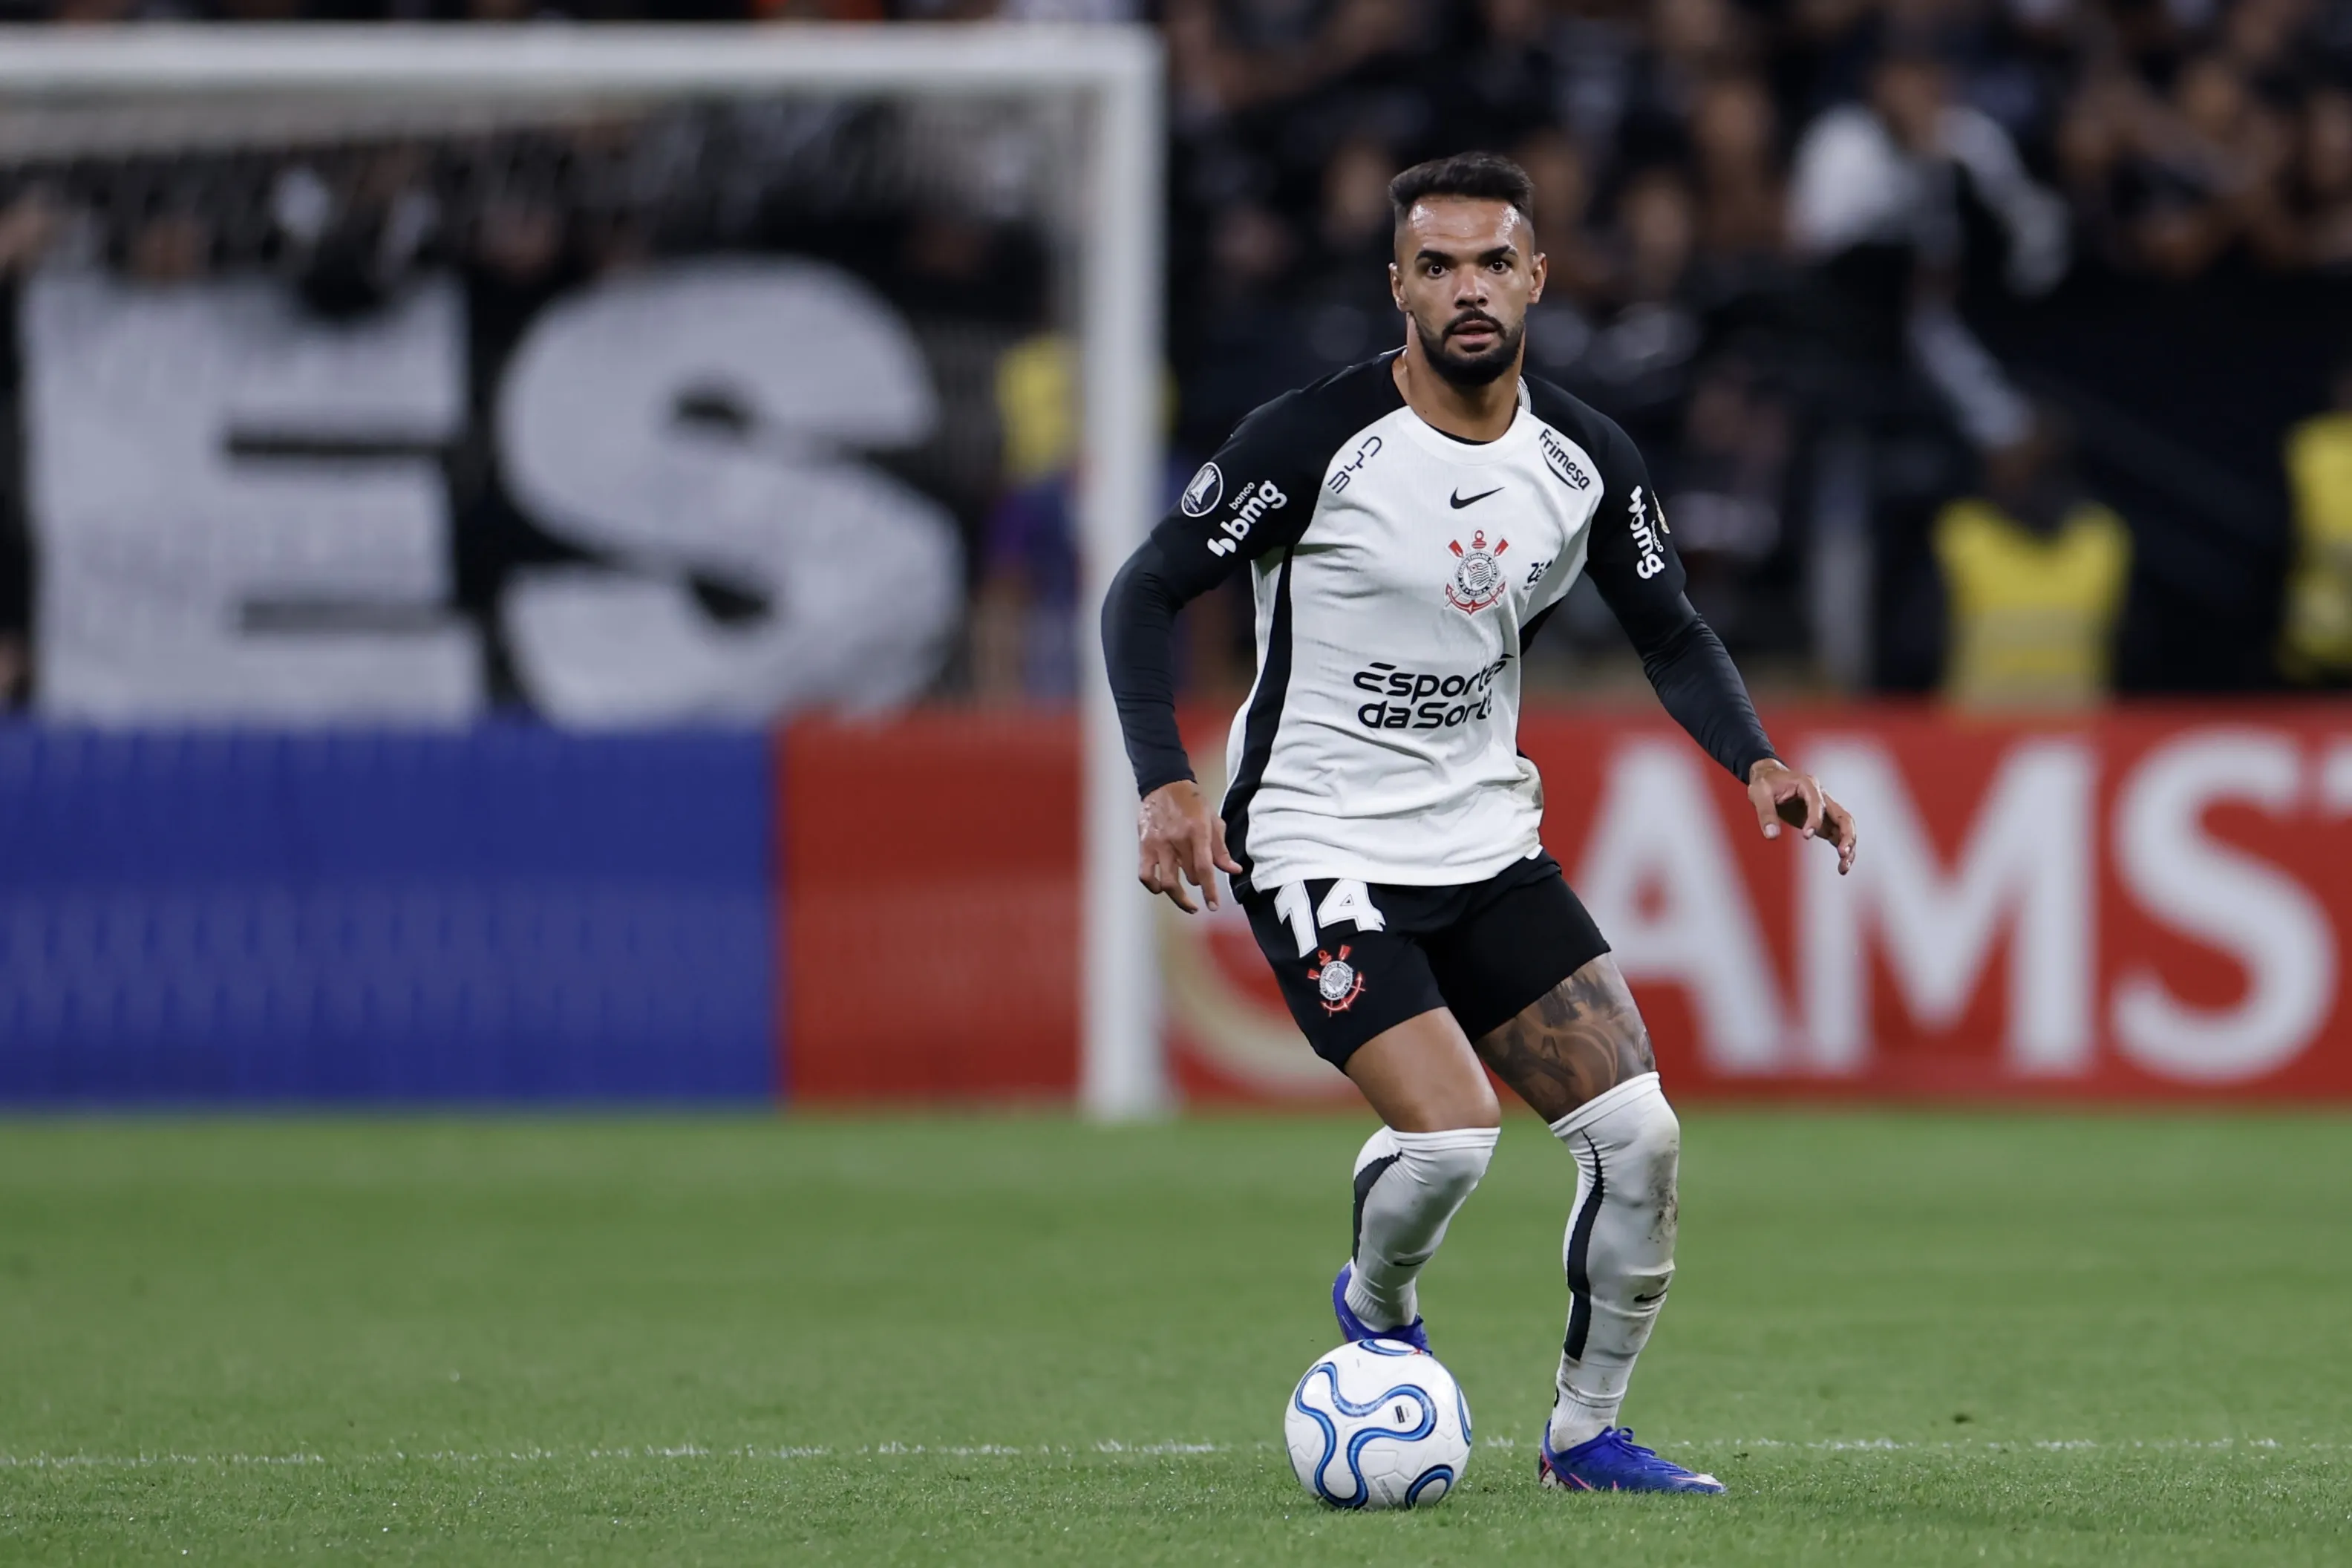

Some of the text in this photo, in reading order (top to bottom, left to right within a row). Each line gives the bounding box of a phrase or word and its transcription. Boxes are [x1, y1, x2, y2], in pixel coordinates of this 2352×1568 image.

[1327, 436, 1382, 494] BYD
[1539, 428, 1590, 491] Frimesa
[1219, 480, 1288, 541] bmg
[1229, 482, 1255, 510] banco
[1629, 503, 1665, 579] bmg
[1274, 878, 1386, 958] 14
[1575, 726, 2352, 1084] AMS
